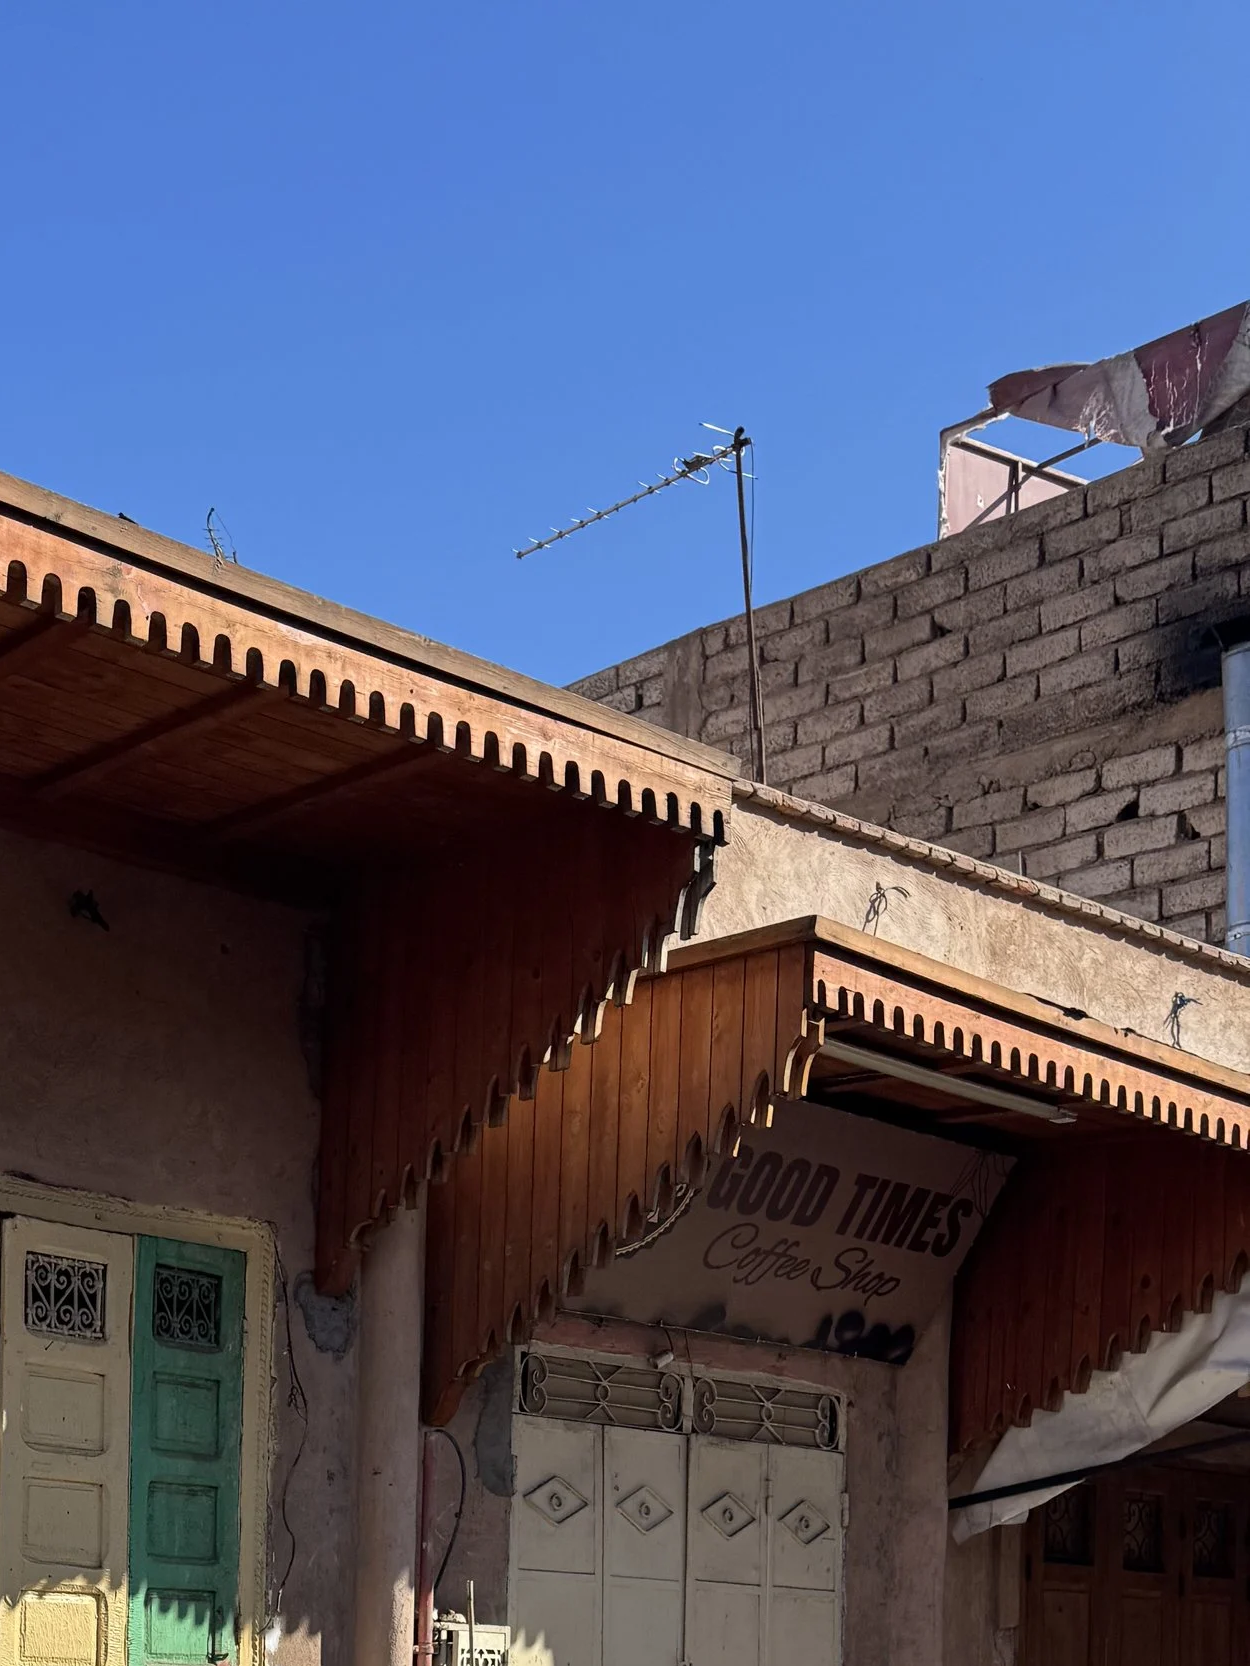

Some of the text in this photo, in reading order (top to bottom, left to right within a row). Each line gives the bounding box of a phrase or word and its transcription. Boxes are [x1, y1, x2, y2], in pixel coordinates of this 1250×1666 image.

[707, 1144, 840, 1226] GOOD
[836, 1173, 975, 1258] TIMES
[703, 1222, 902, 1306] Coffee Shop
